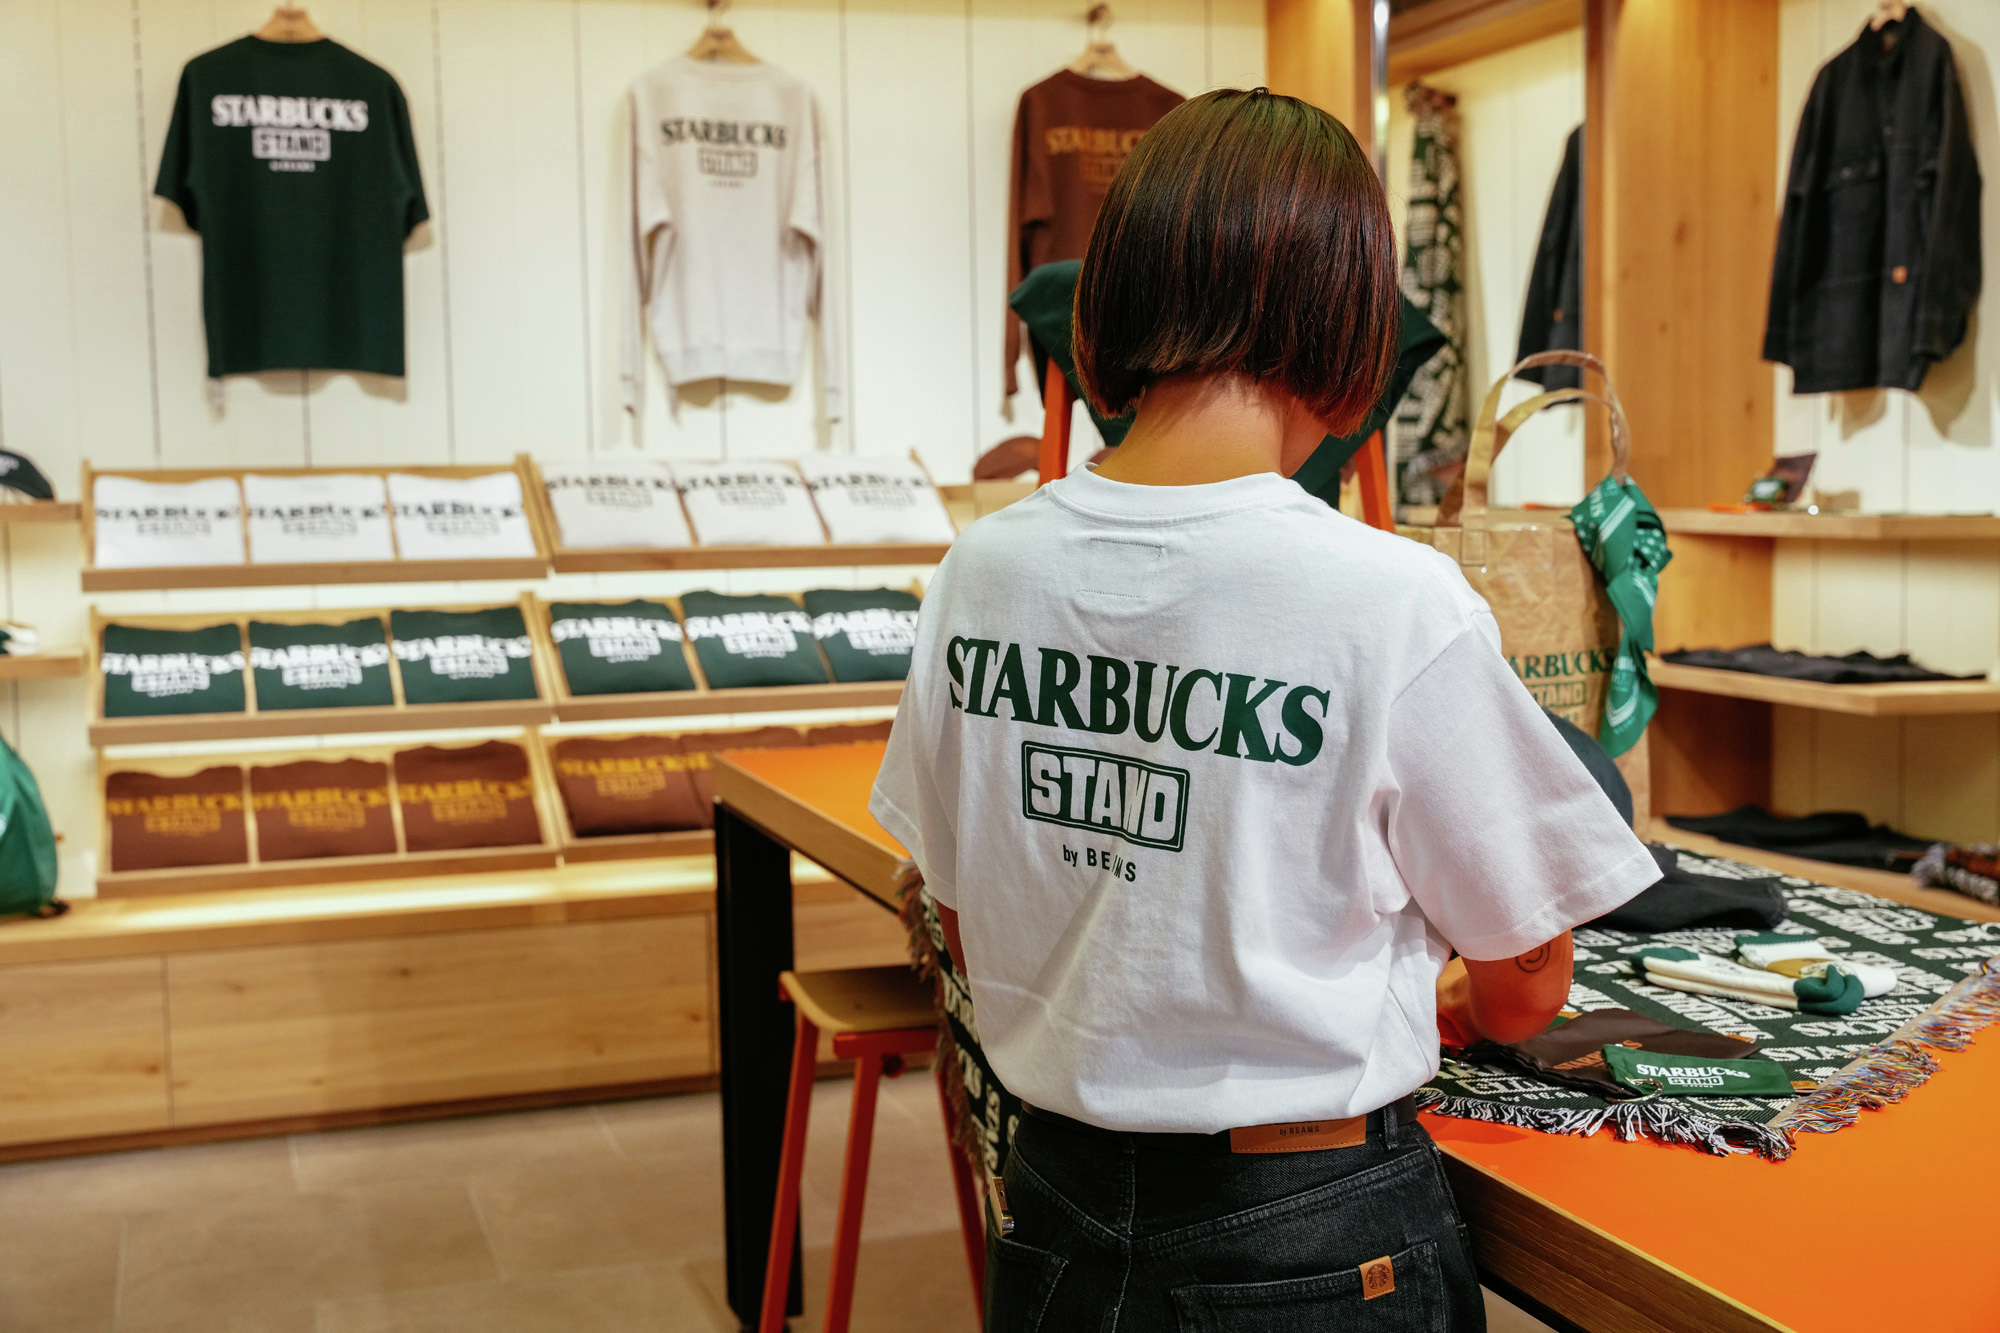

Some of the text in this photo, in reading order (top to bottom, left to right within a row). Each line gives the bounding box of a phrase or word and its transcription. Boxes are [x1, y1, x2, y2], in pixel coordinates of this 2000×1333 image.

[211, 94, 369, 132] STARBUCKS
[660, 117, 787, 151] STARBUCKS
[1505, 648, 1616, 679] ARBUCKS
[946, 635, 1330, 766] STARBUCKS
[1026, 746, 1185, 847] STAND
[1063, 844, 1078, 867] by
[1636, 1064, 1750, 1078] STARBUCKS
[1289, 1125, 1320, 1134] BEAMS
